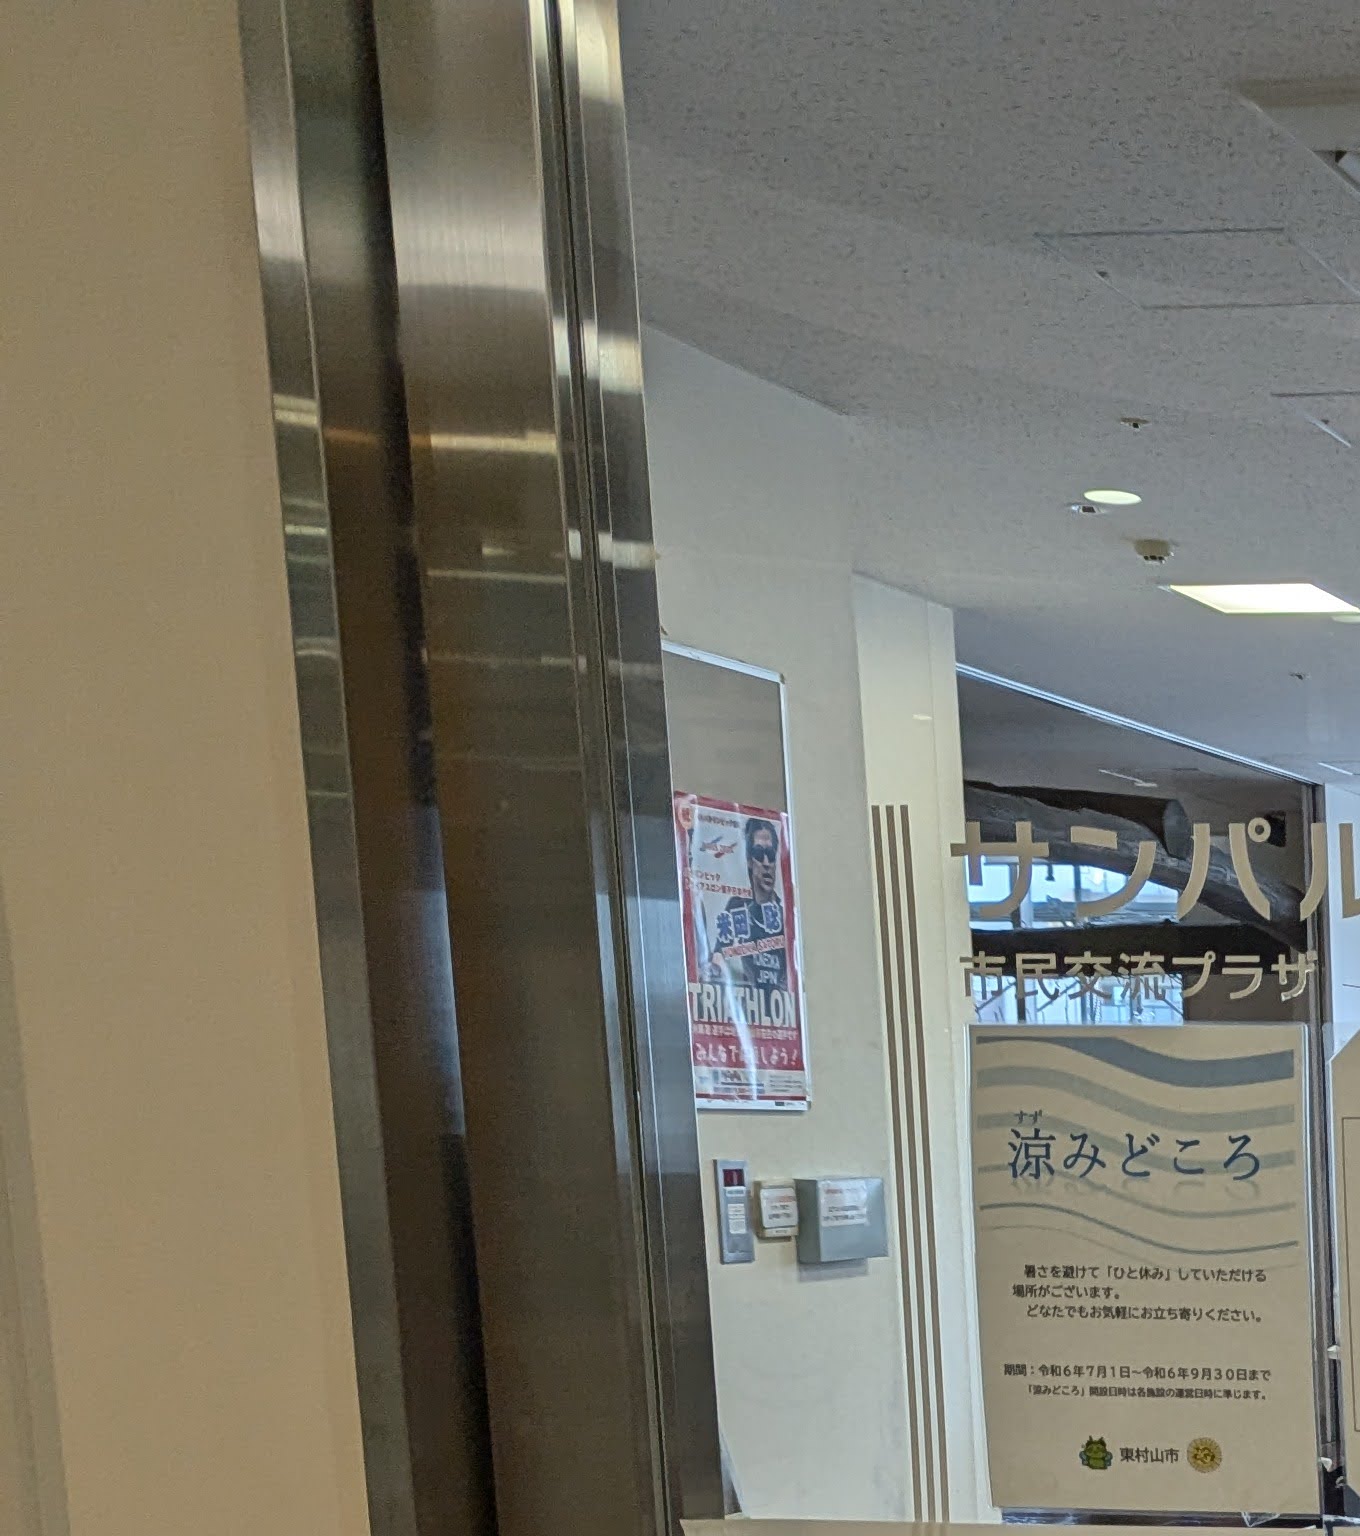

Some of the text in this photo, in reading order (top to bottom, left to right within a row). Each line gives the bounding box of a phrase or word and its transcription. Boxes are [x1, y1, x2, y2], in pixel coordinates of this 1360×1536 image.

[959, 951, 1317, 1002] 市民交流プラザ
[688, 982, 797, 1029] TRIATHLON
[1014, 1109, 1044, 1125] すず
[1007, 1126, 1261, 1182] 涼みどころ
[1023, 1264, 1268, 1283] 暑さを避けて「ひと休み」していただける
[1012, 1284, 1121, 1300] 場所がございます。
[1026, 1304, 1264, 1324] どなたでもお気軽にお立ち寄りください。
[1119, 1446, 1180, 1464] 東村山市
